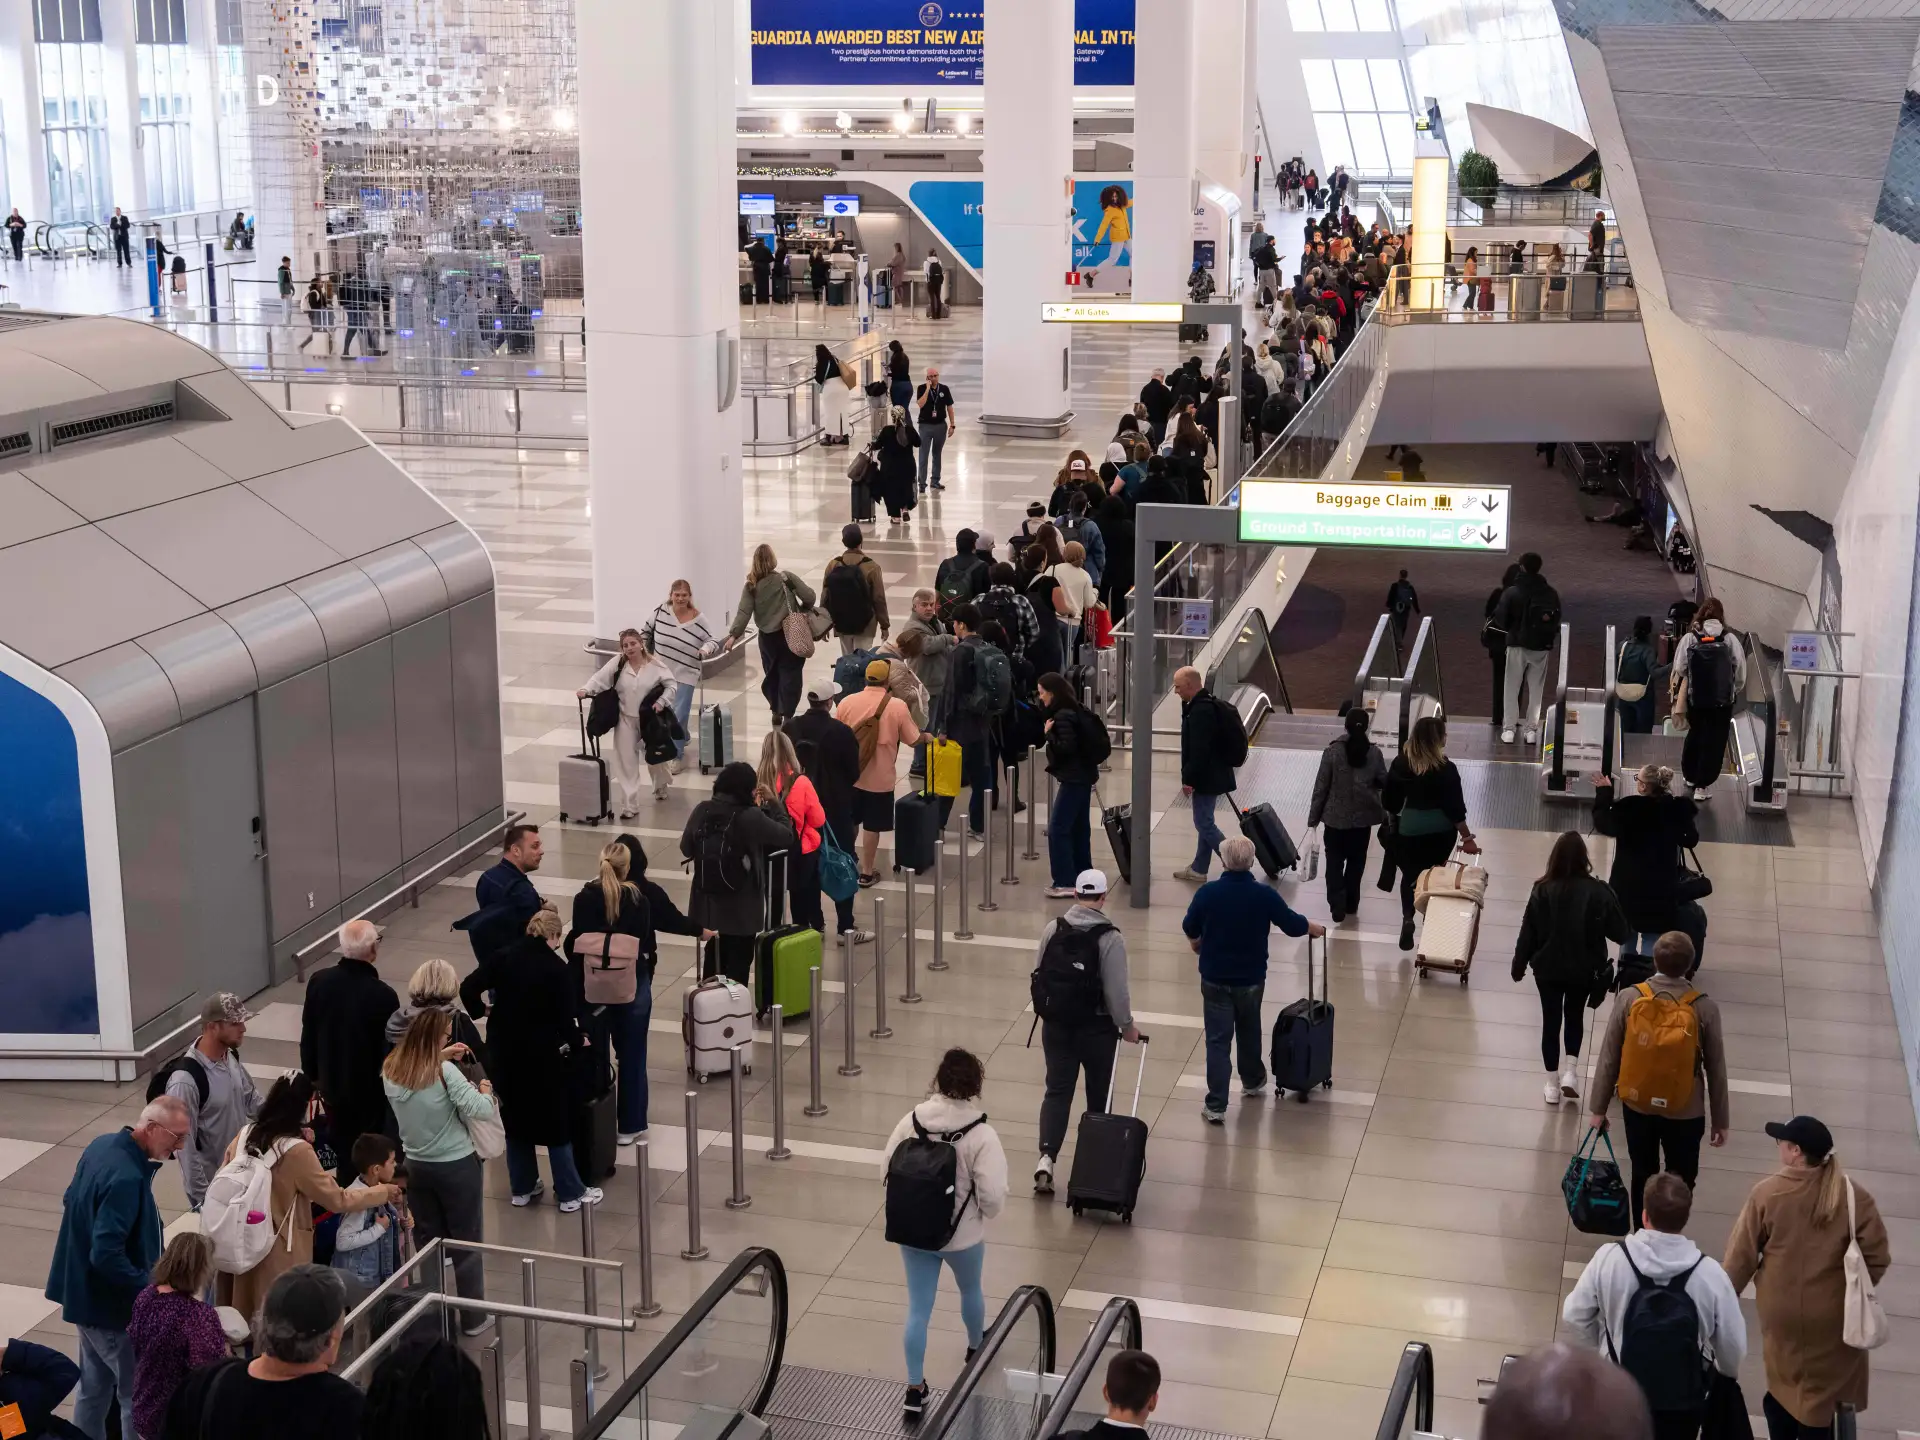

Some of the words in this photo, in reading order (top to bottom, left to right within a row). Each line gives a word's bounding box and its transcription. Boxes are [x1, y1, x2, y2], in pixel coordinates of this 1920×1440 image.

[815, 30, 883, 44] AWARDED
[886, 30, 921, 44] BEST
[924, 30, 957, 44] NEW
[1101, 30, 1118, 44] IN
[846, 48, 881, 56] prestigious
[257, 75, 278, 106] D
[964, 204, 972, 215] If
[1316, 492, 1381, 508] Baggage
[1386, 494, 1427, 507] Claim
[1250, 519, 1307, 534] Ground
[1313, 521, 1426, 540] Transportation
